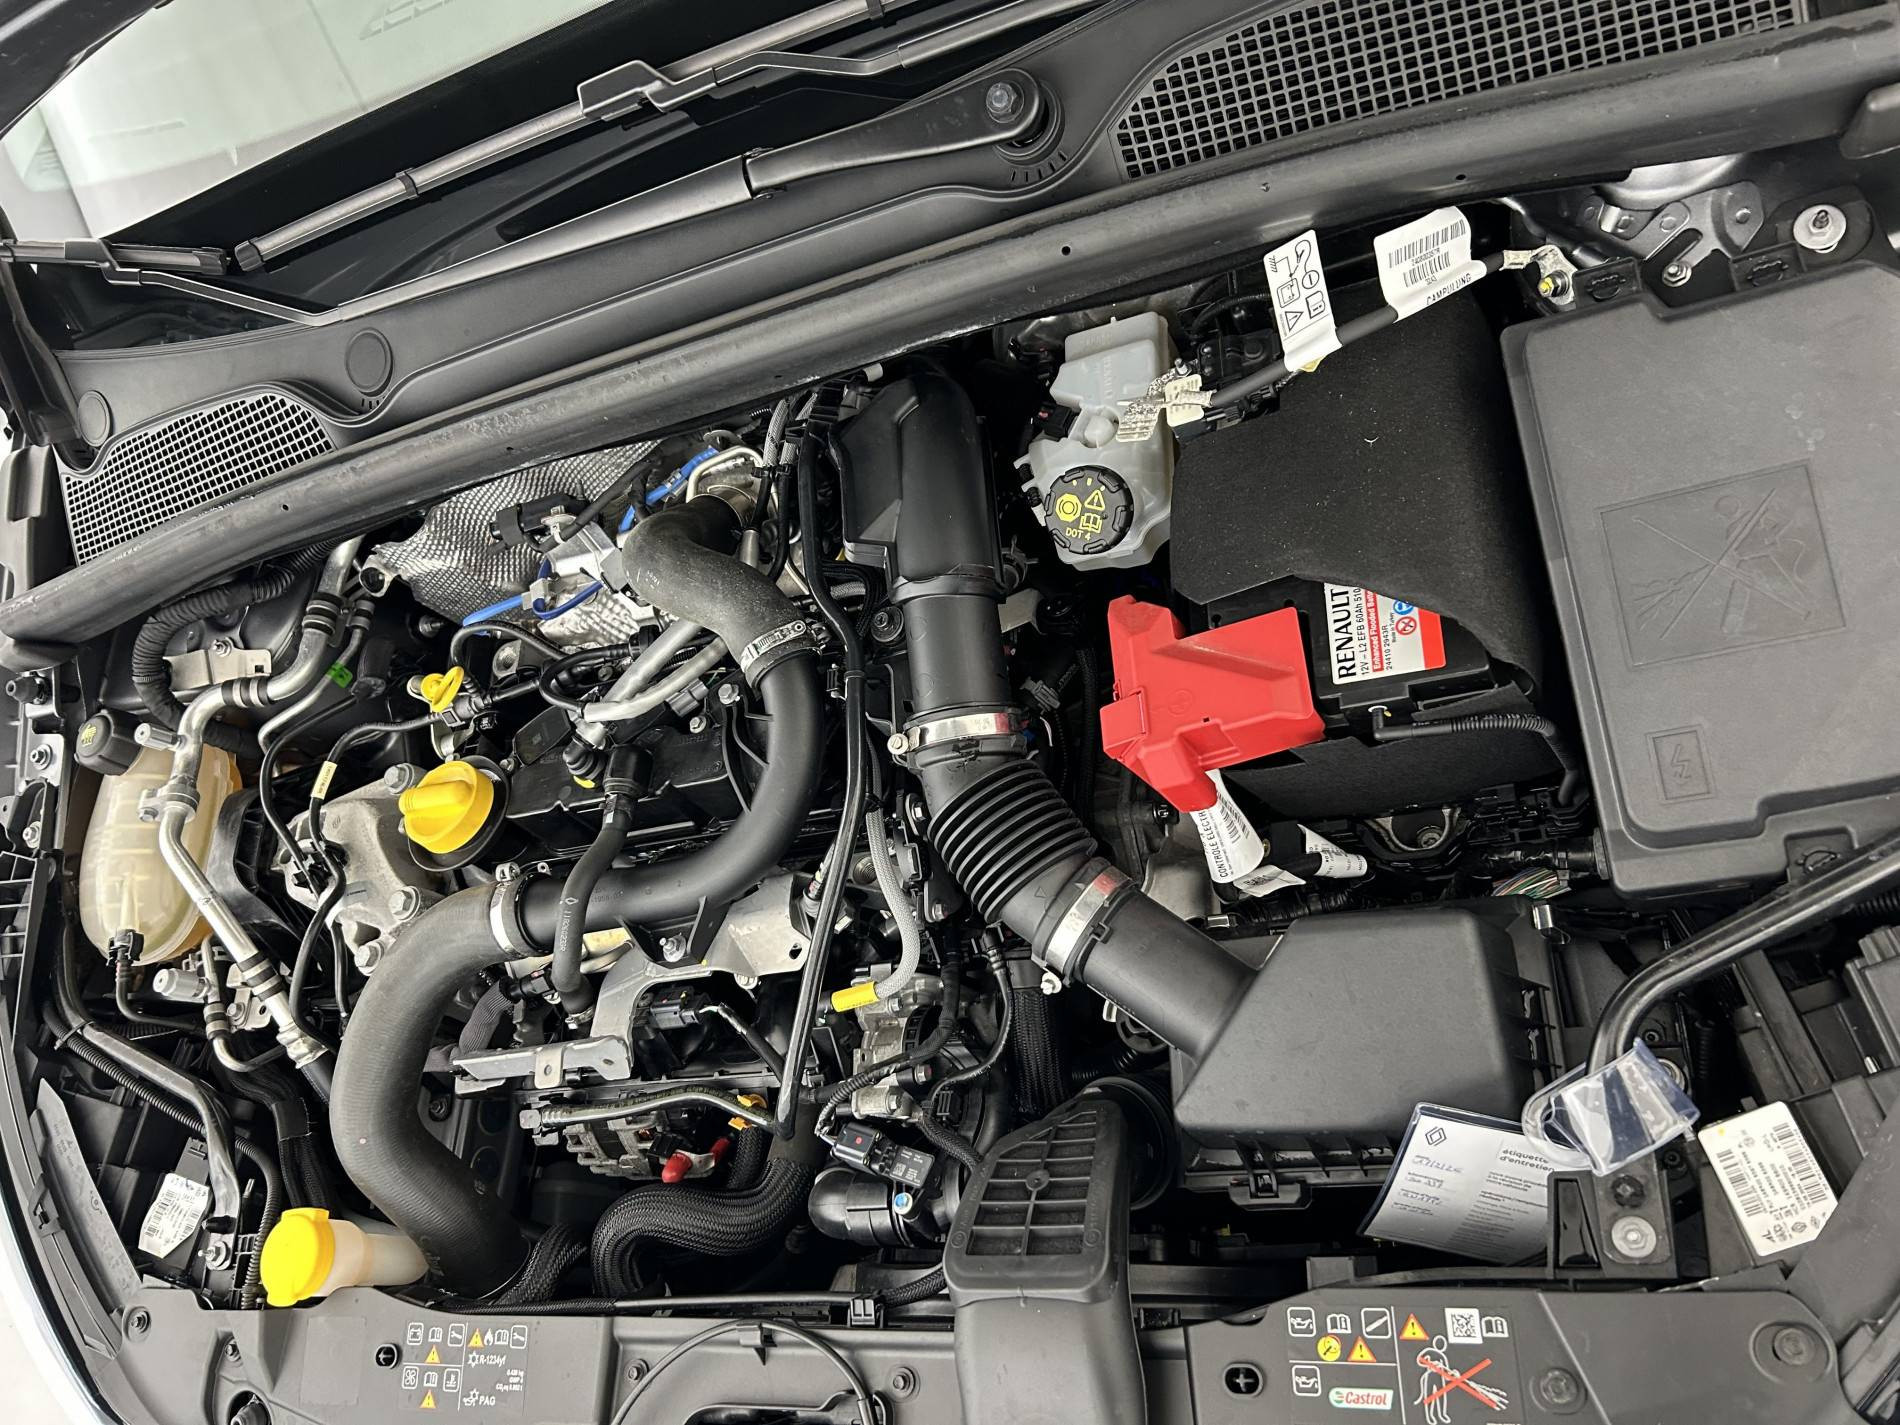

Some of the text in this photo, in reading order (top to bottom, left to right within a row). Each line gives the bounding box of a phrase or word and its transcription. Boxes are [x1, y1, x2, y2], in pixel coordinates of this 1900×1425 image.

[1426, 272, 1472, 306] CAMPULUNG
[1065, 527, 1091, 541] DOT 4
[1354, 603, 1364, 623] 60Ah
[1367, 607, 1380, 635] Flooded
[1331, 588, 1356, 679] RENAULT
[1356, 625, 1366, 641] EFB
[1359, 643, 1367, 652] L2
[1370, 634, 1382, 670] Enhanced
[1360, 661, 1370, 675] 12V
[1385, 649, 1393, 671] 24410
[1209, 841, 1229, 878] CONTROLE
[479, 1354, 506, 1367] R-1234yf
[478, 1395, 496, 1406] PAG
[1345, 1391, 1387, 1406] Castrol
